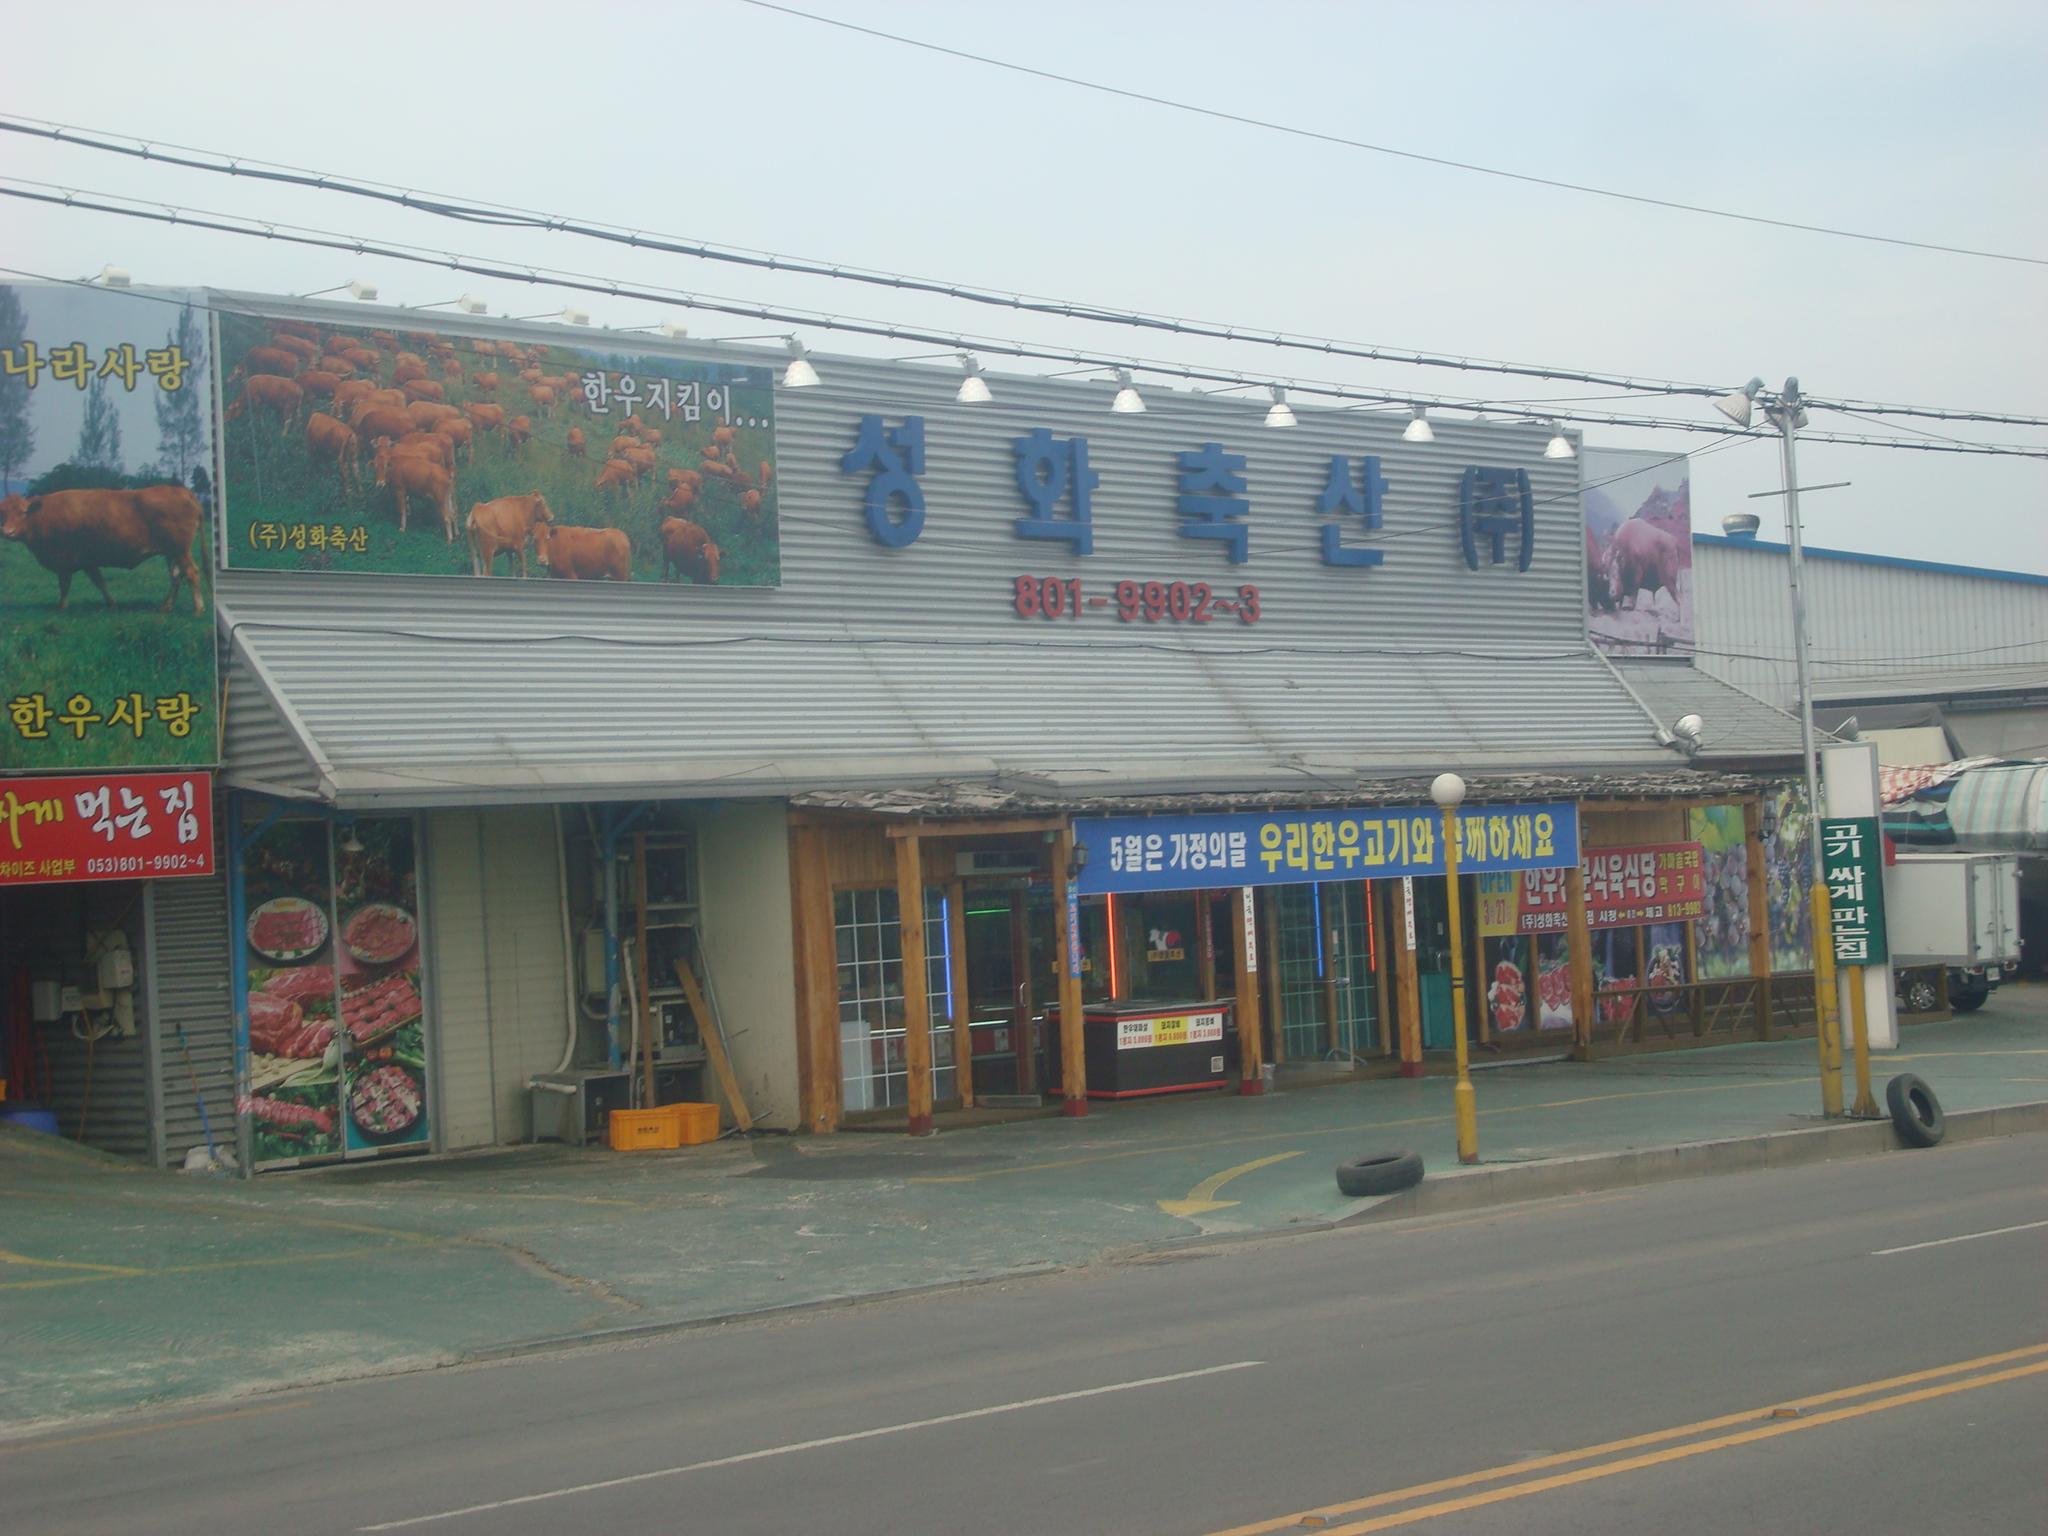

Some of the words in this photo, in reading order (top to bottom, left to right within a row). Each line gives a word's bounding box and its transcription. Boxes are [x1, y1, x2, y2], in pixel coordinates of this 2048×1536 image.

[0, 341, 191, 391] 나라사랑
[249, 520, 369, 552] (주)성화축산
[9, 692, 201, 740] 한우사랑
[74, 785, 152, 842] 먹는
[158, 780, 199, 845] 집
[1110, 833, 1164, 872] 5월은
[1169, 831, 1247, 870] 가정의달
[1823, 823, 1863, 858] 고기
[39, 857, 76, 878] 사업부
[1827, 865, 1866, 901] 싸게
[1831, 906, 1870, 960] 파는집
